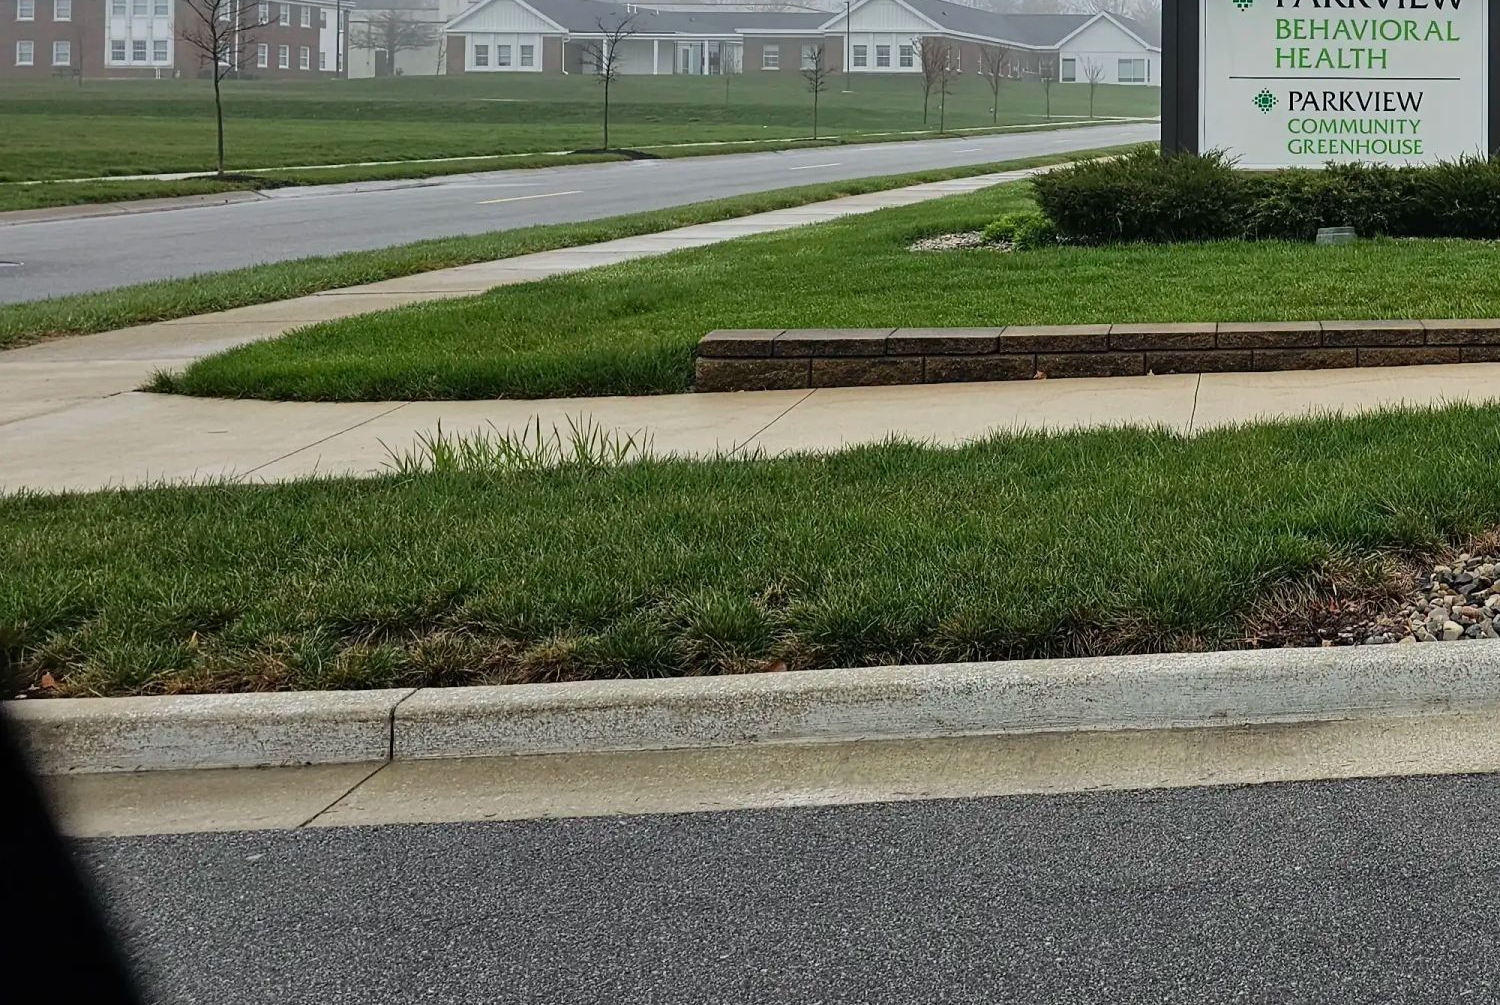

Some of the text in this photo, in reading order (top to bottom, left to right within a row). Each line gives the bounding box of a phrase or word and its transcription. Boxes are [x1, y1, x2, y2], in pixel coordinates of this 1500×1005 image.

[1276, 19, 1460, 41] BEHAVIORAL
[1276, 48, 1387, 69] HEALTH
[1288, 91, 1424, 112] PARKVIEW
[1288, 118, 1421, 134] COMMUNITY
[1288, 139, 1423, 155] GREENHOUSE
